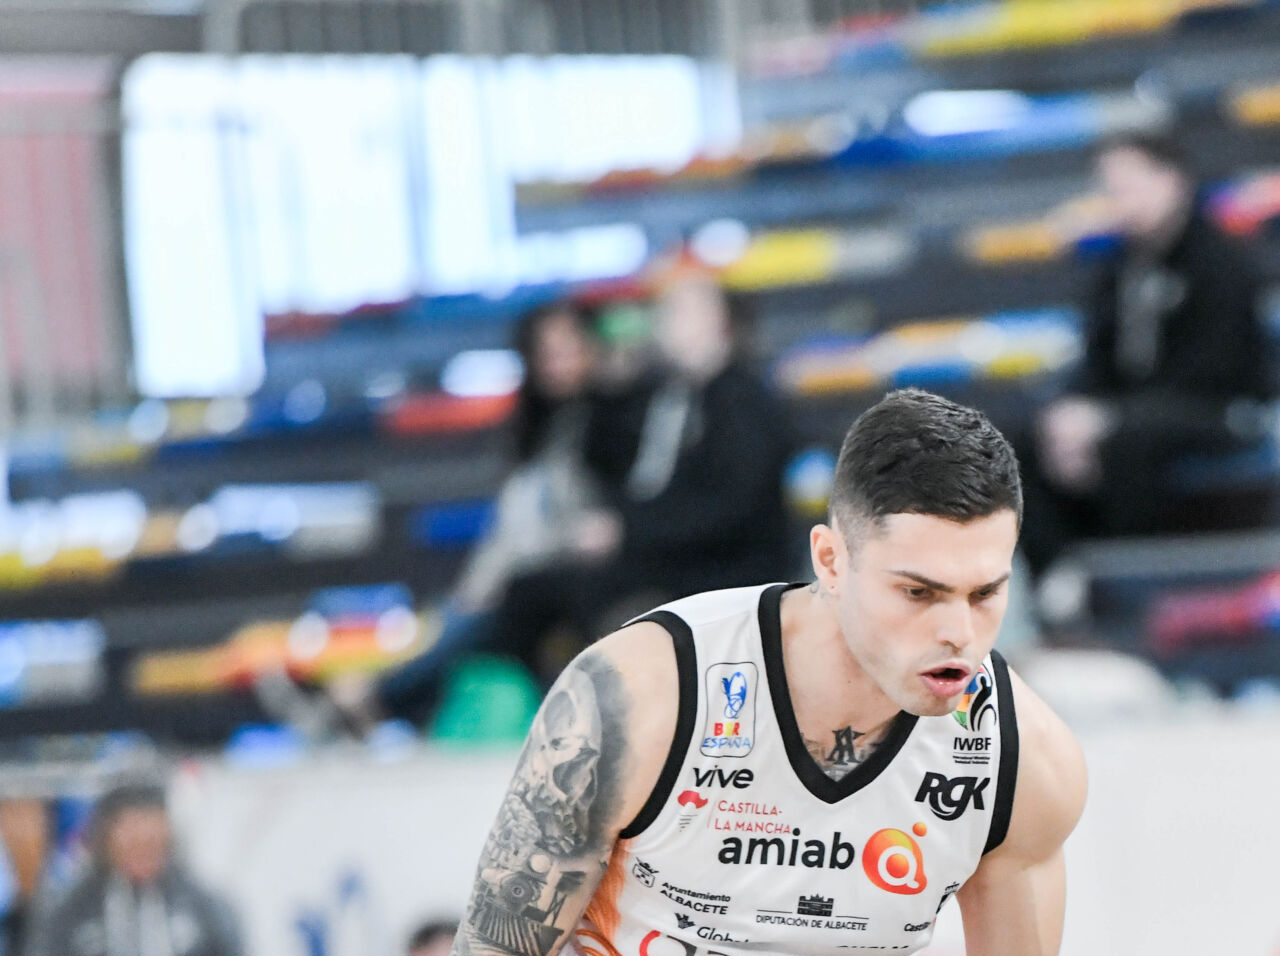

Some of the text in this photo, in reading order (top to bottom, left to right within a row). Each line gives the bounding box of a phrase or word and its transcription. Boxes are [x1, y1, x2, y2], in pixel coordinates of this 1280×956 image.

[953, 737, 991, 751] IWBF
[693, 765, 754, 789] vive
[914, 771, 991, 821] RGK
[717, 800, 782, 816] CASTILLA-
[714, 818, 791, 834] LA MANCHA
[718, 828, 855, 870] amiab
[662, 882, 731, 902] Ayuntamiento
[660, 889, 728, 915] ALBACETE
[811, 919, 822, 929] DE
[824, 921, 868, 931] ALBACETE
[697, 926, 749, 943] Glob
